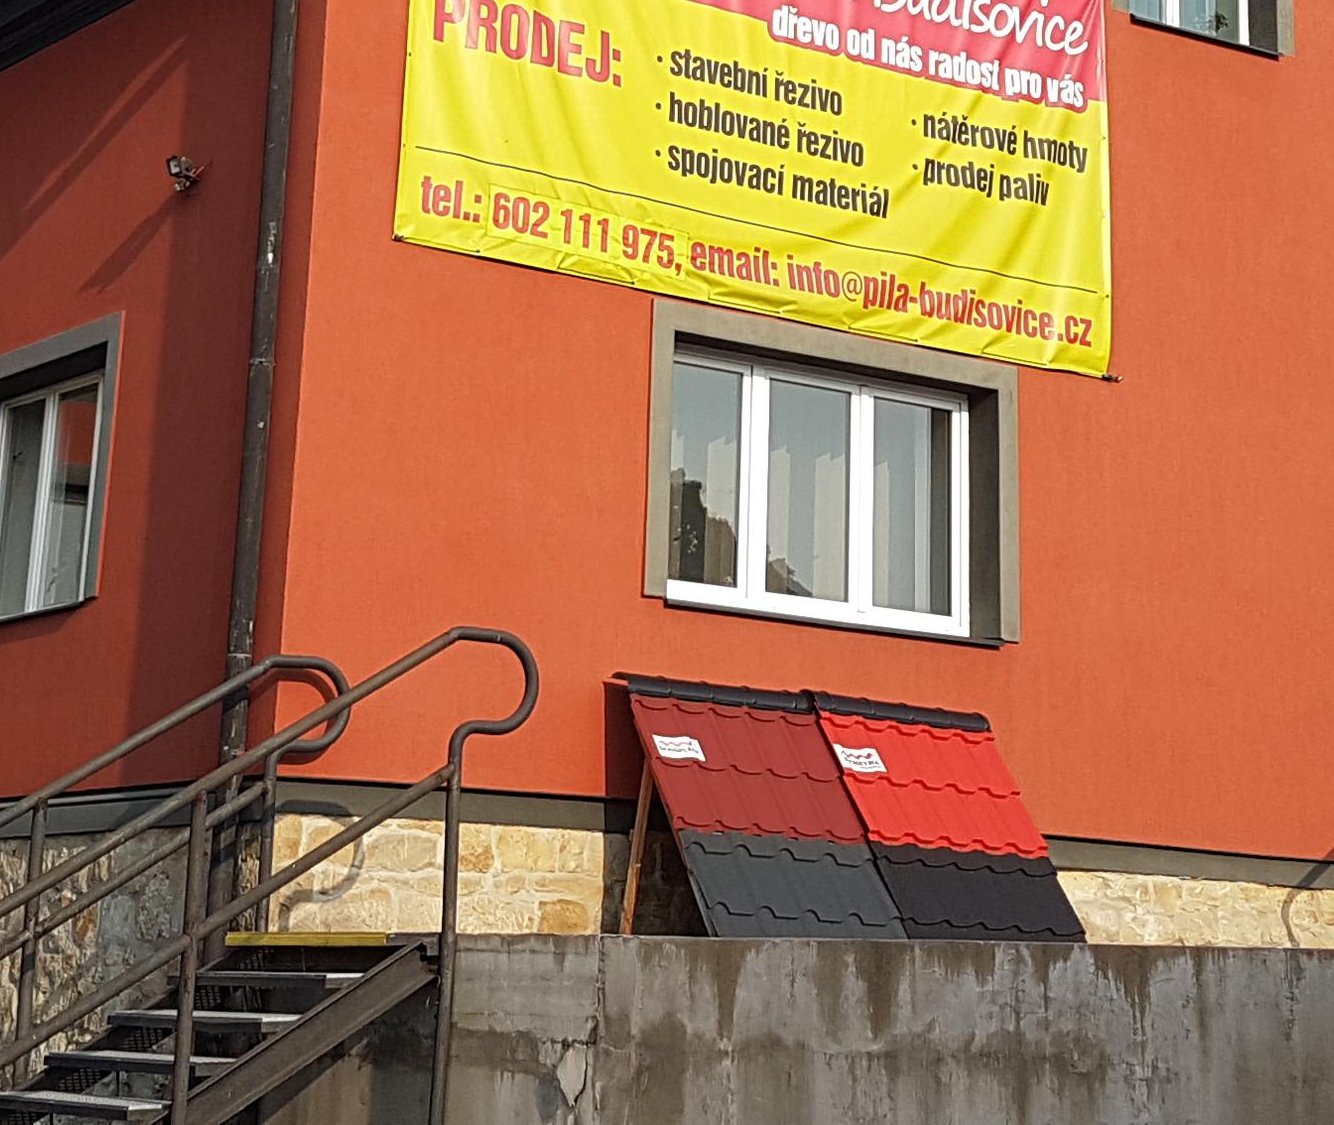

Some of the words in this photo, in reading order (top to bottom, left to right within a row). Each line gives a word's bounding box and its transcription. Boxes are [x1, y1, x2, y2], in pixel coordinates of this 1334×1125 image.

[669, 49, 768, 98] stavební
[774, 70, 843, 116] řezivo
[772, 5, 839, 50] dřevo
[847, 24, 874, 60] od
[881, 36, 923, 71] nás
[928, 49, 1000, 94] radost
[1005, 67, 1042, 99] pro
[1047, 74, 1084, 108] vás
[668, 91, 790, 150] hoblované
[797, 121, 864, 167] řezivo
[923, 111, 1017, 155] nátěrové
[1023, 129, 1088, 173] hmoty
[667, 144, 784, 196] spojovací
[792, 173, 890, 219] materiál
[923, 157, 995, 198] prodej
[999, 173, 1050, 206] paliv
[421, 176, 482, 223] tel.:
[492, 192, 550, 239] 602
[560, 208, 609, 253] 111
[622, 224, 682, 276] 975,
[690, 241, 779, 286] email:
[787, 254, 1092, 347] info@pila-budisovice.cz
